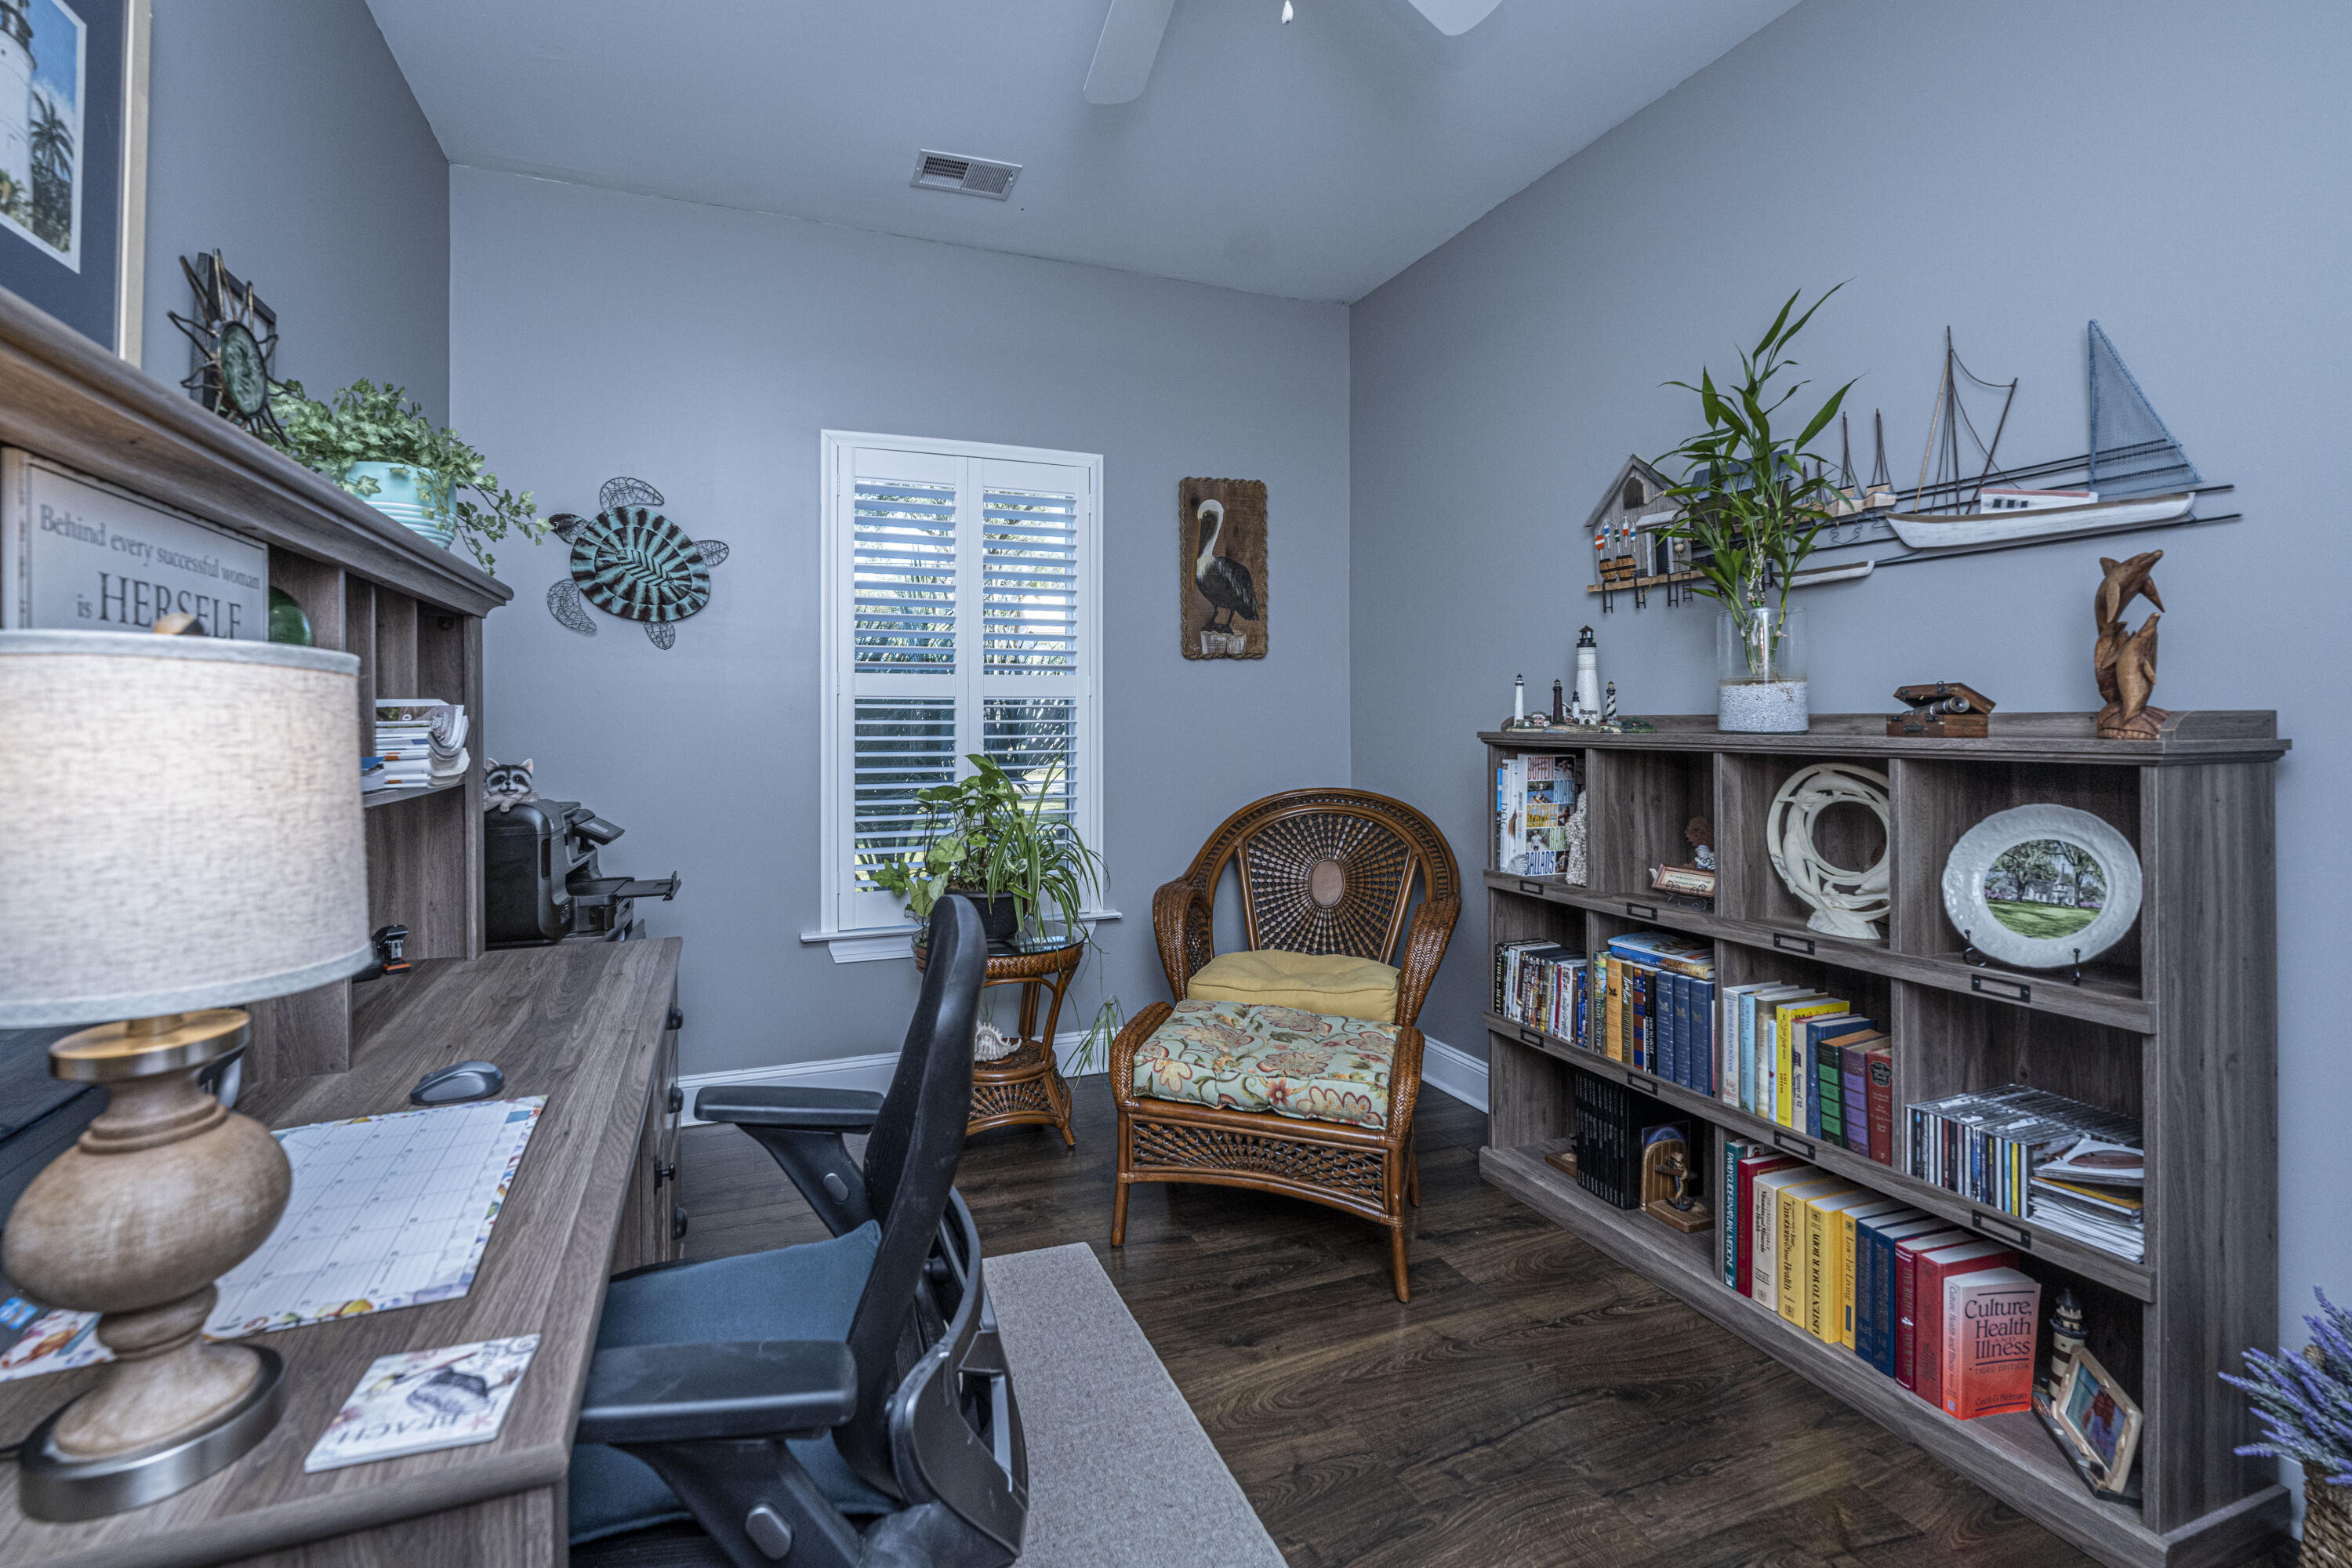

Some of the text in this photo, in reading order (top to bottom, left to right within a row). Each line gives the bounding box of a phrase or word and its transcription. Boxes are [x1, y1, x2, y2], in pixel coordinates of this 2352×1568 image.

[38, 503, 260, 590] Behind every successful woman
[76, 593, 93, 619] is
[1527, 757, 1554, 780] BUFFETT
[1555, 780, 1575, 804] BOATS
[1526, 804, 1559, 828] BEACHES
[1783, 1202, 1791, 1243] Emotions
[1783, 1261, 1791, 1290] Health
[1844, 1236, 1854, 1301] Low-Fat Living
[1903, 1267, 1914, 1286] LIVE
[1813, 1285, 1820, 1299] TO
[1903, 1287, 1914, 1313] RIGHT
[1964, 1298, 2032, 1319] Culture,
[1901, 1316, 1914, 1327] 4
[1948, 1312, 1957, 1336] Health
[1976, 1316, 2031, 1339] Health
[1903, 1333, 1913, 1356] YOUR
[1948, 1336, 1957, 1351] and
[1976, 1339, 2031, 1360] Illness
[1903, 1358, 1913, 1378] TYPE
[1948, 1352, 1957, 1372] Illness
[1976, 1363, 2029, 1375] THIRD EDITION
[1975, 1396, 1992, 1406] Cecil
[2000, 1393, 2027, 1402] Helman
